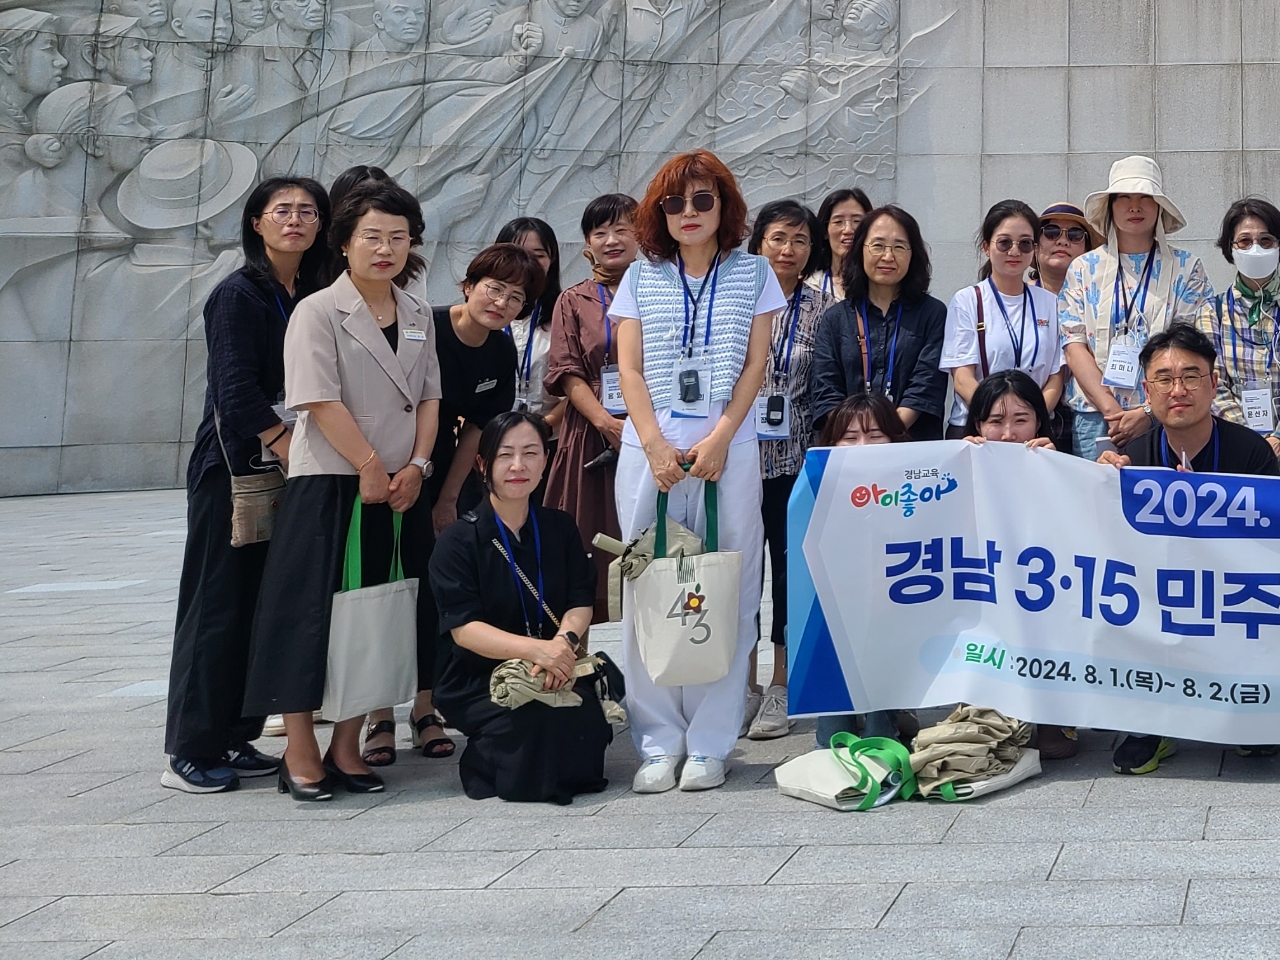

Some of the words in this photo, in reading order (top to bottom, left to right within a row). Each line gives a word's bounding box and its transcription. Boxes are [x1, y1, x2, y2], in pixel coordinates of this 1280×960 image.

[851, 477, 958, 518] 아이좋아
[904, 468, 940, 480] 경남교육
[1133, 478, 1270, 528] 2024.
[886, 537, 1002, 605] 경남
[1014, 546, 1141, 627] 3·15
[965, 642, 1006, 669] 일시
[1209, 682, 1271, 704] 2.(금)
